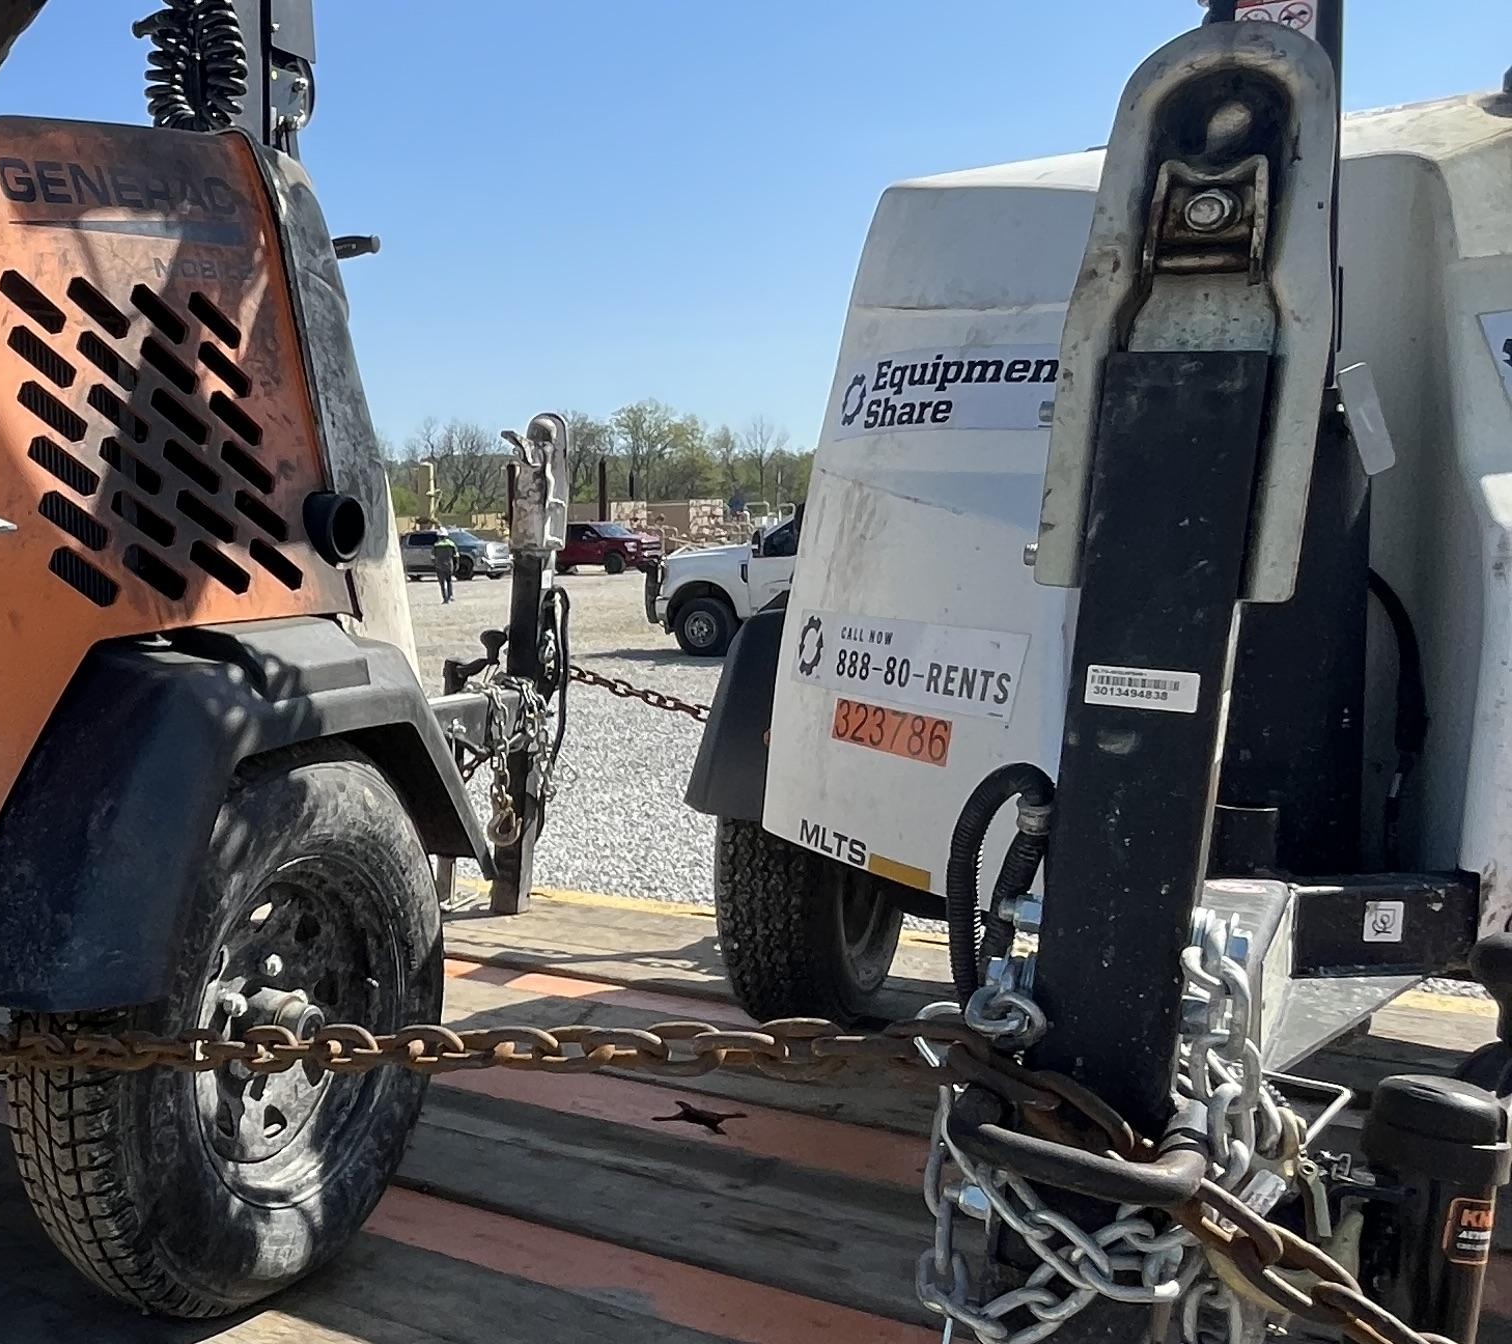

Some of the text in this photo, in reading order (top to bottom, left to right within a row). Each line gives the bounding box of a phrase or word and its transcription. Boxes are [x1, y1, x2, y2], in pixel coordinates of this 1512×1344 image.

[871, 354, 1060, 396] Equipmen
[864, 396, 953, 430] Share
[840, 626, 894, 646] CALL NOW
[836, 648, 1012, 705] 888-80-RENTS
[835, 698, 949, 762] 323786
[799, 818, 867, 867] MLTS
